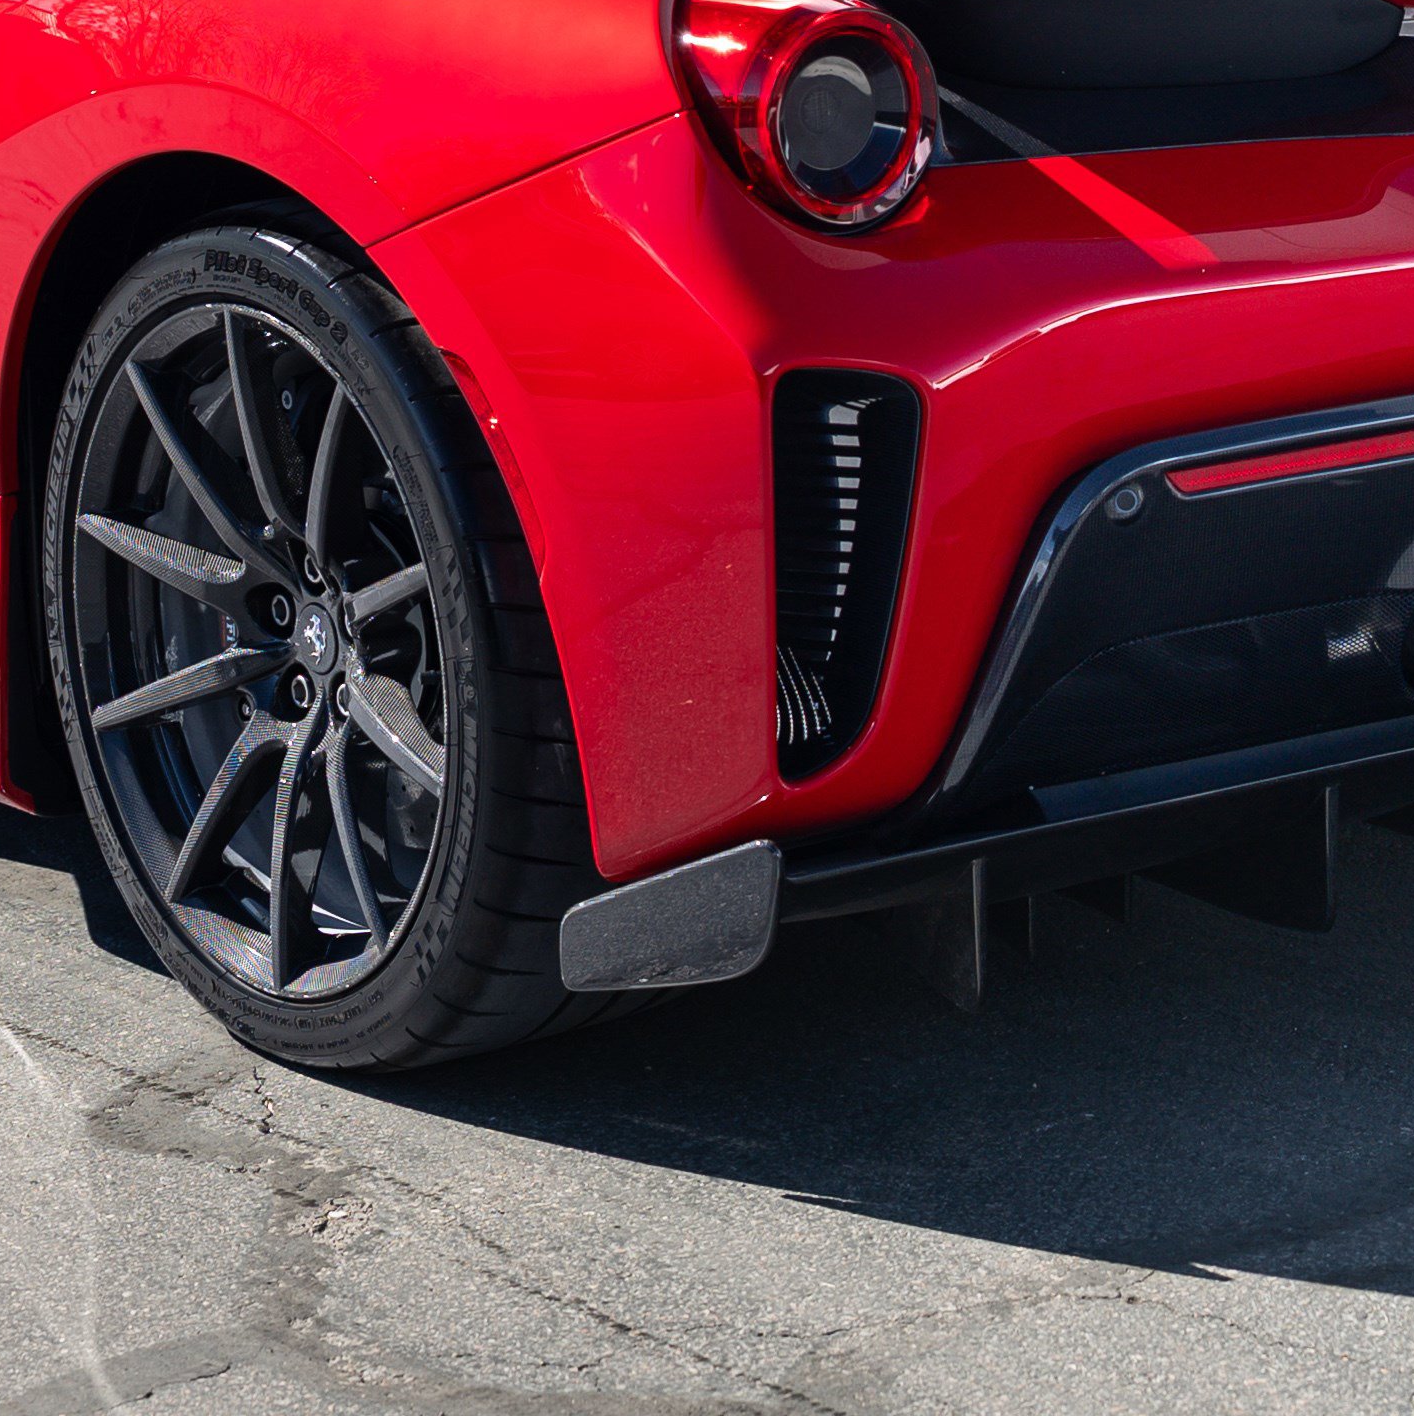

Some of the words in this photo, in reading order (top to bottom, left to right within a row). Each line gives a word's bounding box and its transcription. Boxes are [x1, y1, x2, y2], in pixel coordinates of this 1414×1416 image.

[246, 257, 299, 299] Sport
[298, 289, 331, 328] Cup
[330, 322, 348, 345] 2
[46, 412, 73, 591] MICHELIN
[441, 713, 478, 913] MICHELIN
